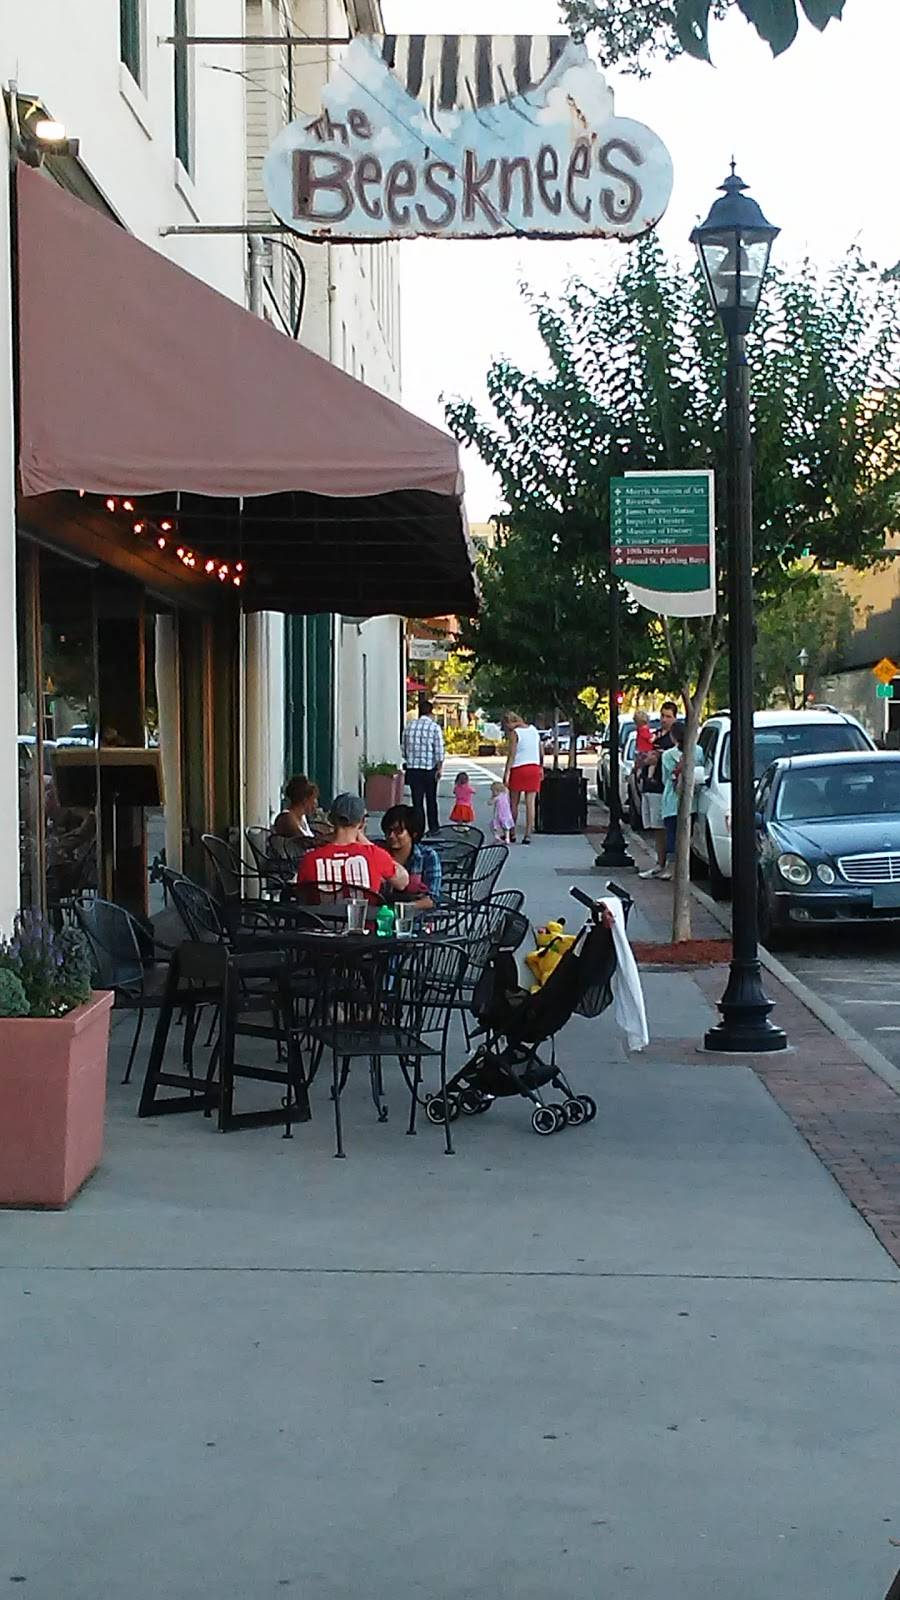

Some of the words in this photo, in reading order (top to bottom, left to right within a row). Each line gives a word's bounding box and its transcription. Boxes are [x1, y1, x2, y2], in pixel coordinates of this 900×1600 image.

[305, 108, 374, 145] The
[625, 487, 650, 495] Morris
[651, 487, 682, 495] Museum
[683, 487, 691, 495] of
[692, 487, 704, 495] Art
[625, 508, 647, 516] James
[625, 518, 656, 527] Imperial
[658, 527, 665, 535] of
[666, 527, 691, 536] History
[626, 537, 649, 545] Visitor
[651, 537, 676, 545] Center
[643, 547, 664, 555] Street
[626, 557, 648, 565] Broad
[660, 557, 688, 566] Parking
